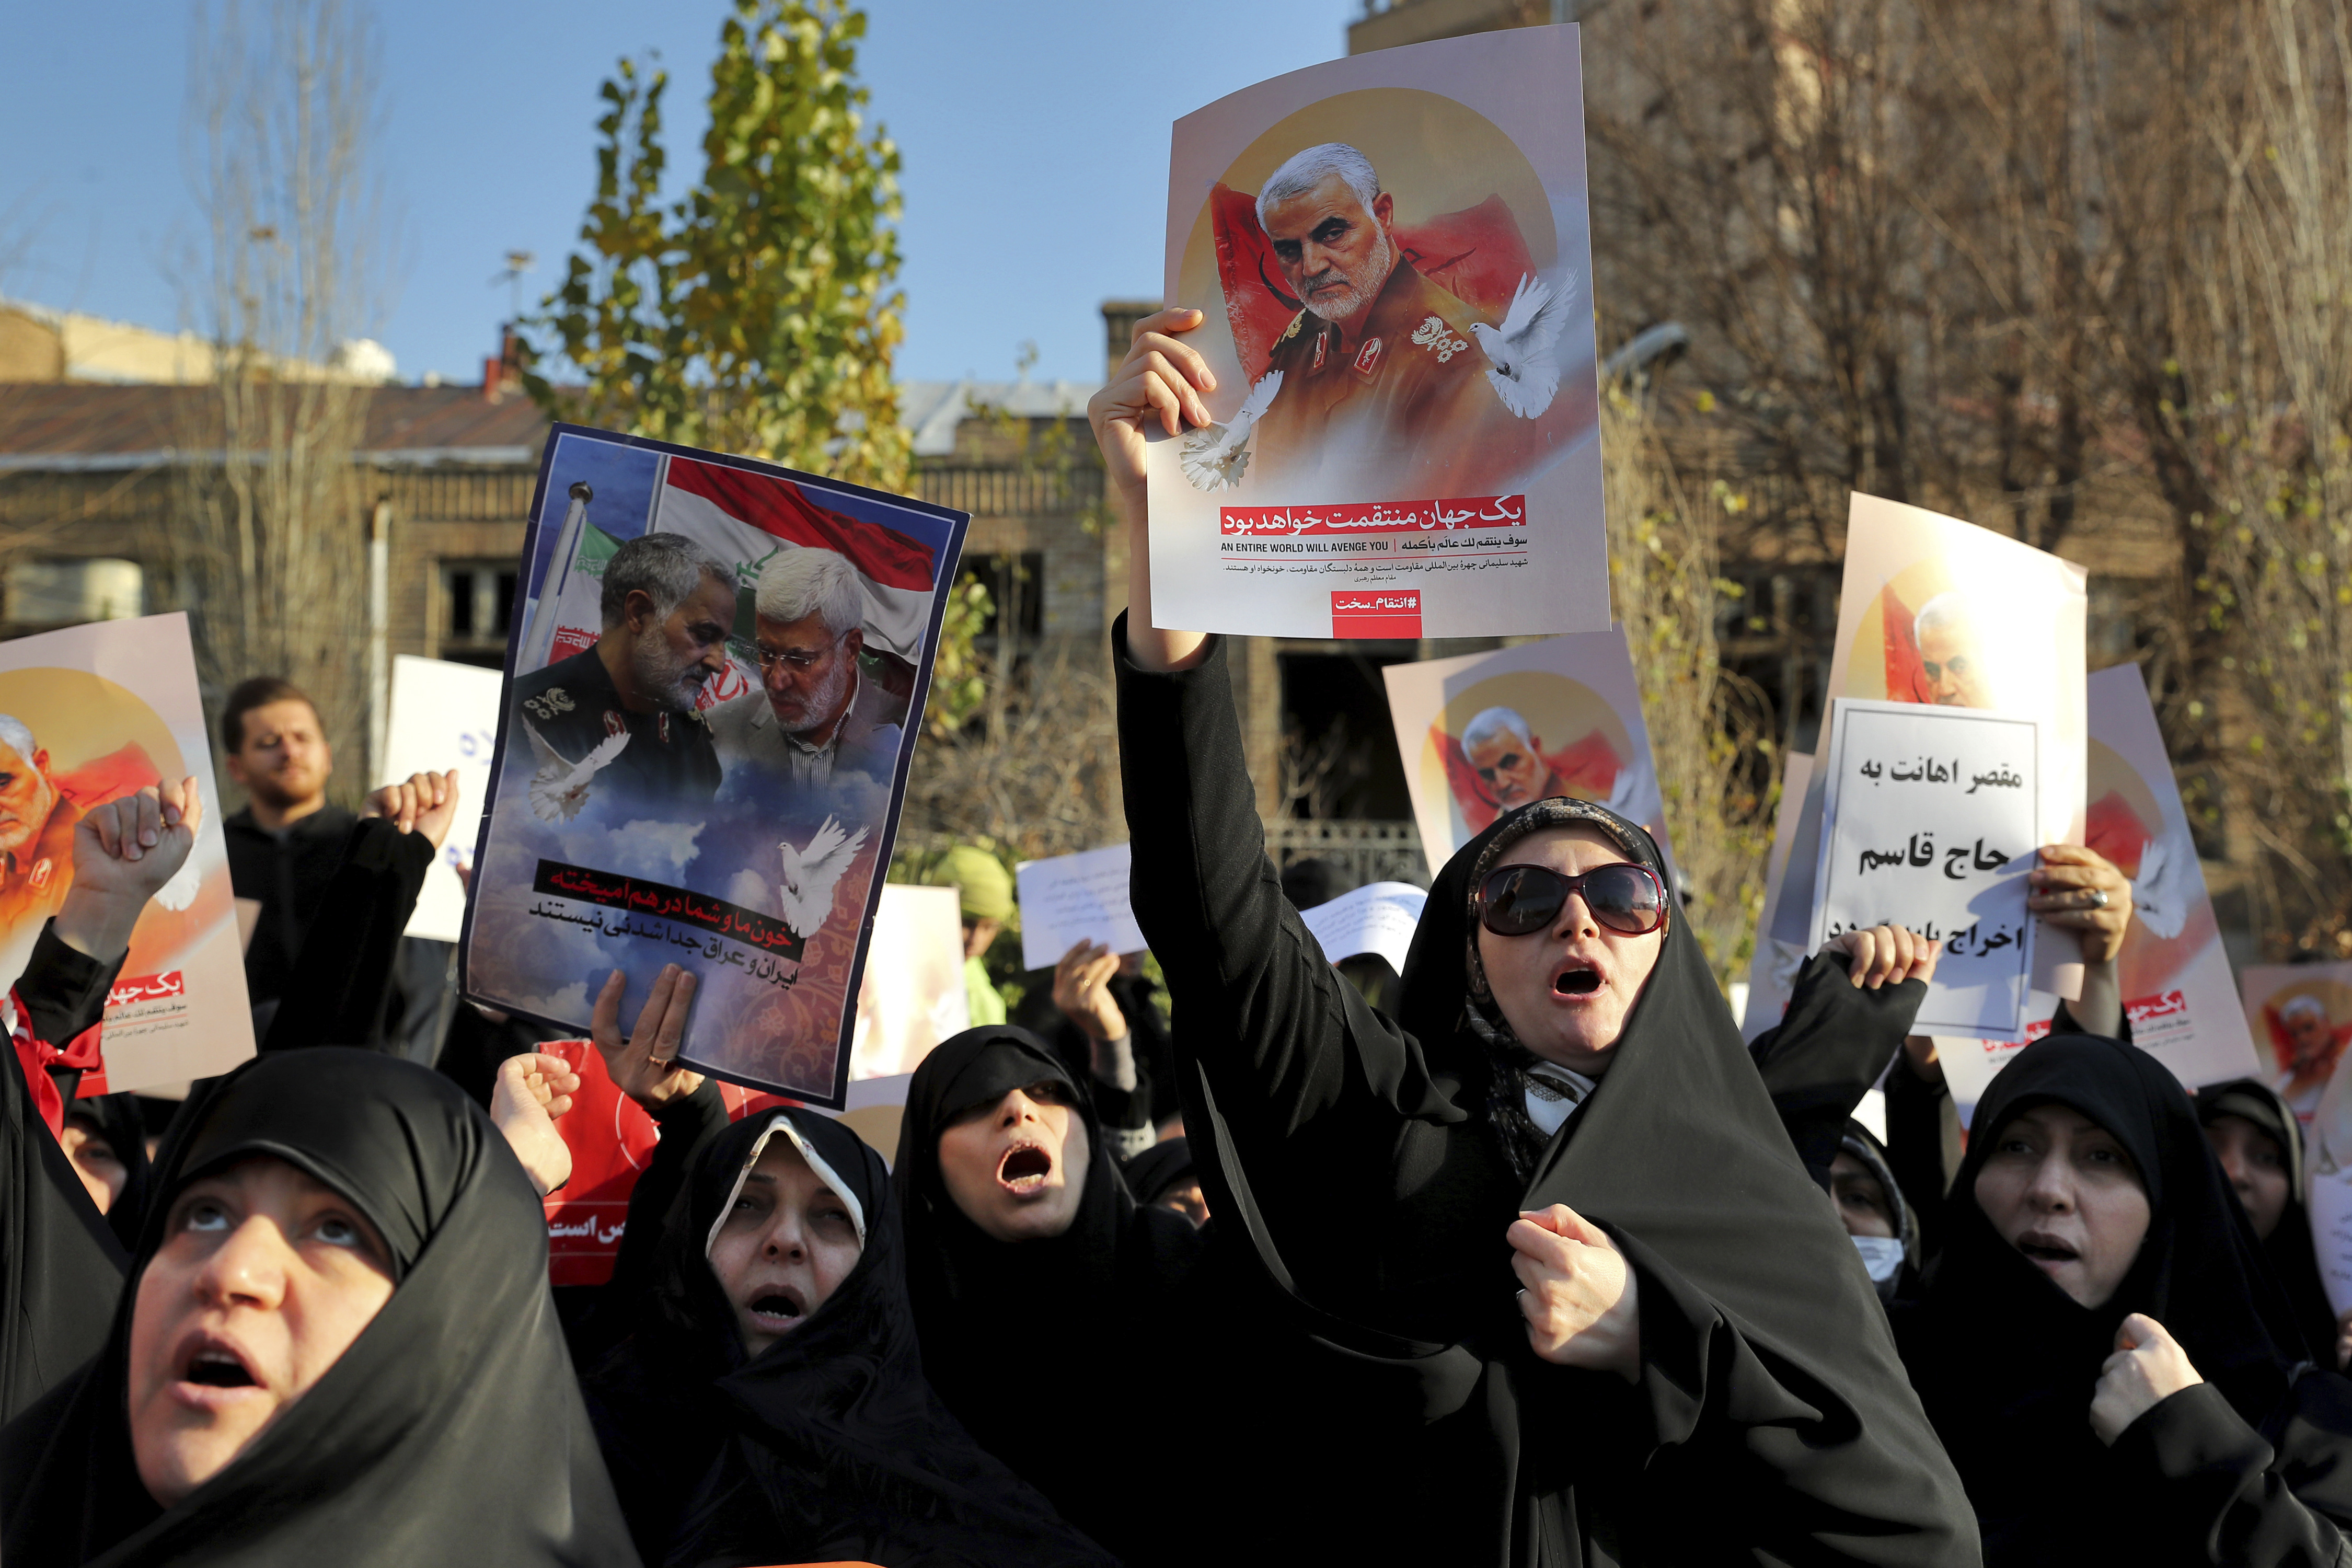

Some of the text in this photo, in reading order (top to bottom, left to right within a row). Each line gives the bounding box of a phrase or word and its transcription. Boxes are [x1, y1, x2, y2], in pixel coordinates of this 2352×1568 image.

[1224, 495, 1522, 536] یک جهان منتقمت خواهد بود
[1221, 541, 1388, 552] AN ENTIRE WORLD WILL AVENGE YOU
[1503, 534, 1527, 547] سوف
[1249, 564, 1255, 573] او
[1258, 564, 1284, 573] خونخواه
[1319, 562, 1352, 574] دلبستگان
[1395, 561, 1423, 571] مقاومت
[1479, 558, 1508, 570] سلیمانی
[1510, 558, 1528, 567] شهید
[1370, 575, 1384, 584] معظم
[1385, 574, 1397, 584] مقام
[1335, 596, 1417, 610] #انتقام_سخت
[1860, 755, 2023, 794] مقصر اهانت به
[1859, 831, 2010, 880] حاج قاسم
[550, 871, 792, 948] خون ما و شما در هم آمیخته
[528, 901, 799, 990] ایران و عراق جدا شدنی نیستند
[1946, 923, 2026, 958] اخراج
[145, 971, 181, 997] یک
[548, 1214, 597, 1238] است
